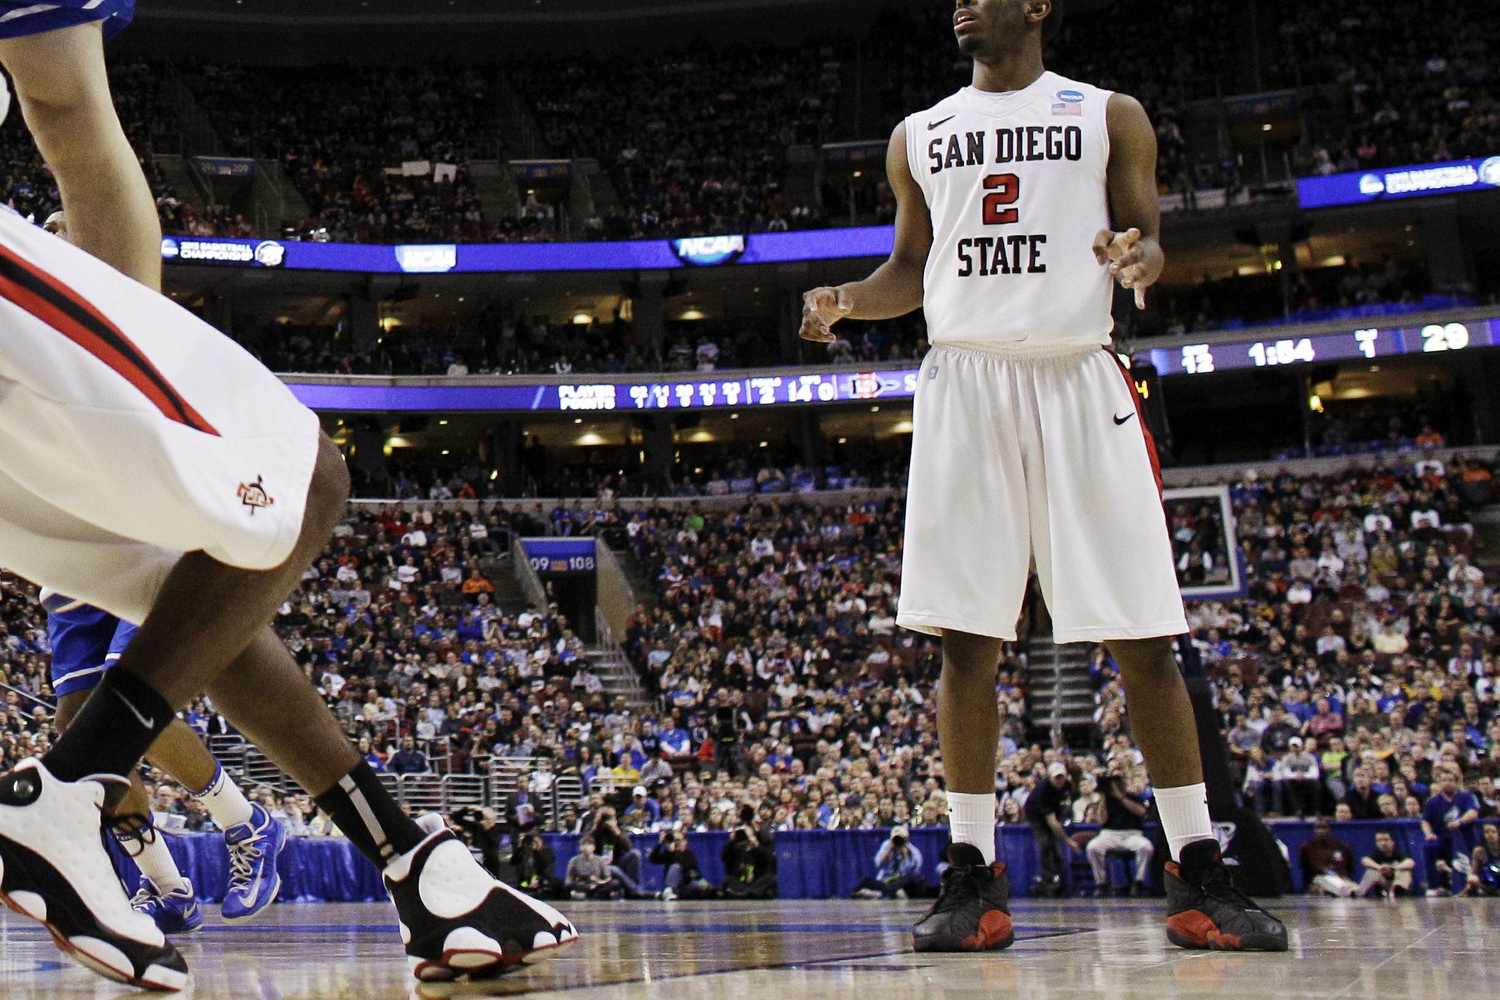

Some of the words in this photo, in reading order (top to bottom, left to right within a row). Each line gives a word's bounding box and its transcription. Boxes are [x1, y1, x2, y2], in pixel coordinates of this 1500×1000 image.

[928, 131, 985, 175] SAN
[995, 126, 1082, 164] DIEGO
[982, 173, 1020, 225] 2
[679, 234, 744, 257] NCAA
[957, 234, 1047, 277] STATE
[558, 384, 616, 398] PLAYER
[560, 397, 615, 410] POINTS
[530, 557, 550, 571] 09
[569, 556, 595, 571] 108
